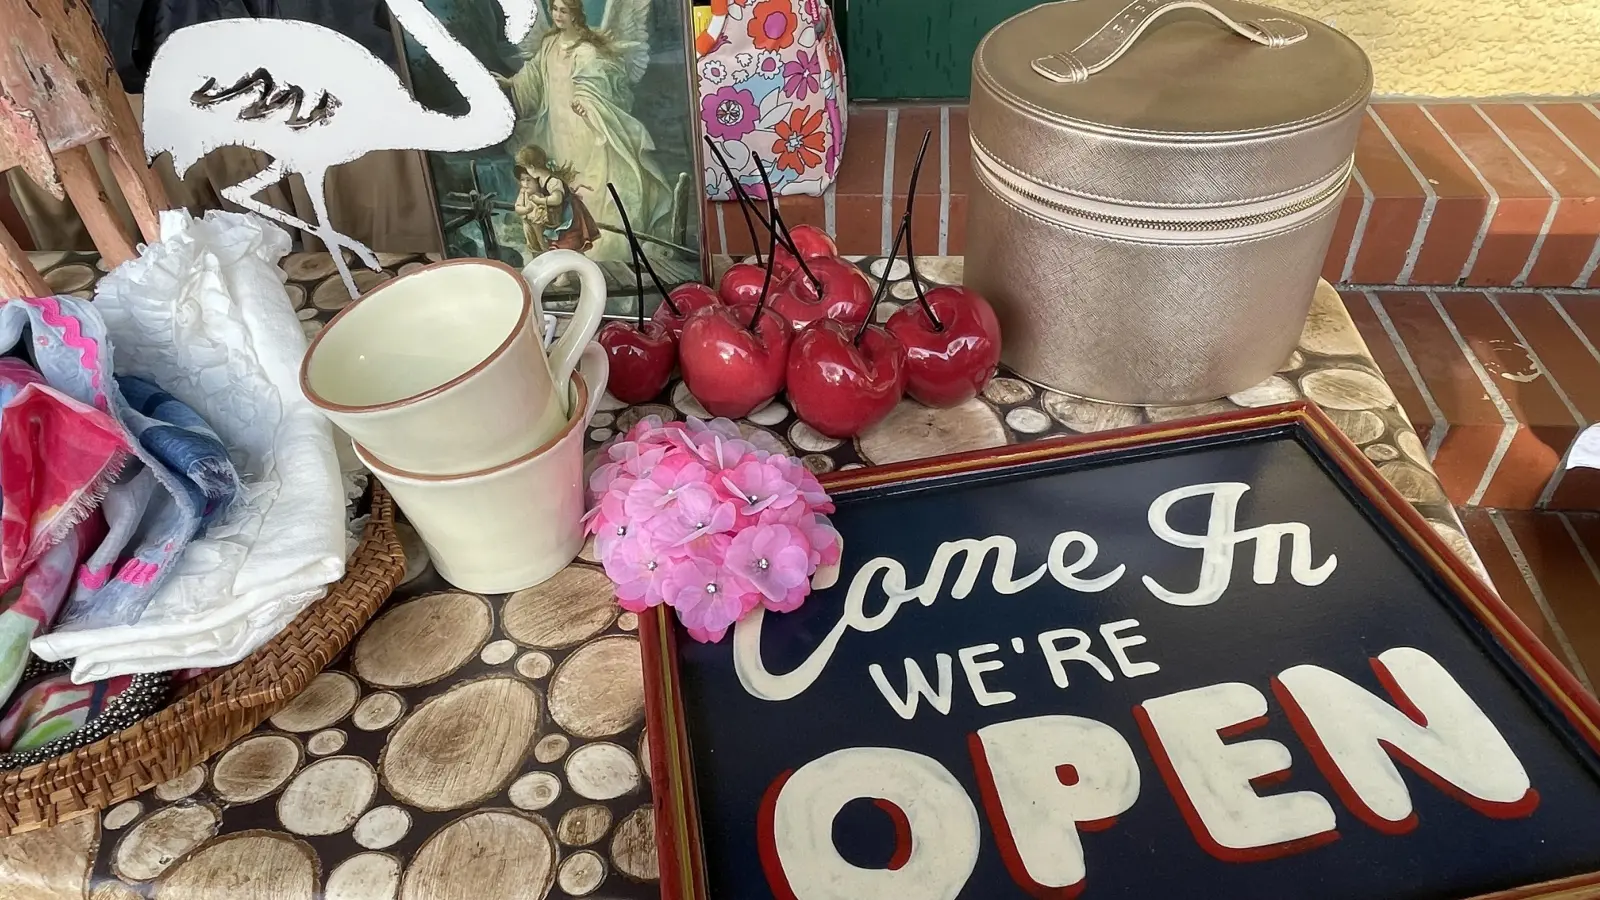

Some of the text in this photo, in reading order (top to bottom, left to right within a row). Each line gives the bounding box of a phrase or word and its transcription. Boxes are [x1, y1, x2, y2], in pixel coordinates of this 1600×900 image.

[733, 481, 1338, 701] Come In
[868, 618, 1161, 721] WE'RE
[759, 646, 1540, 900] OPEN
